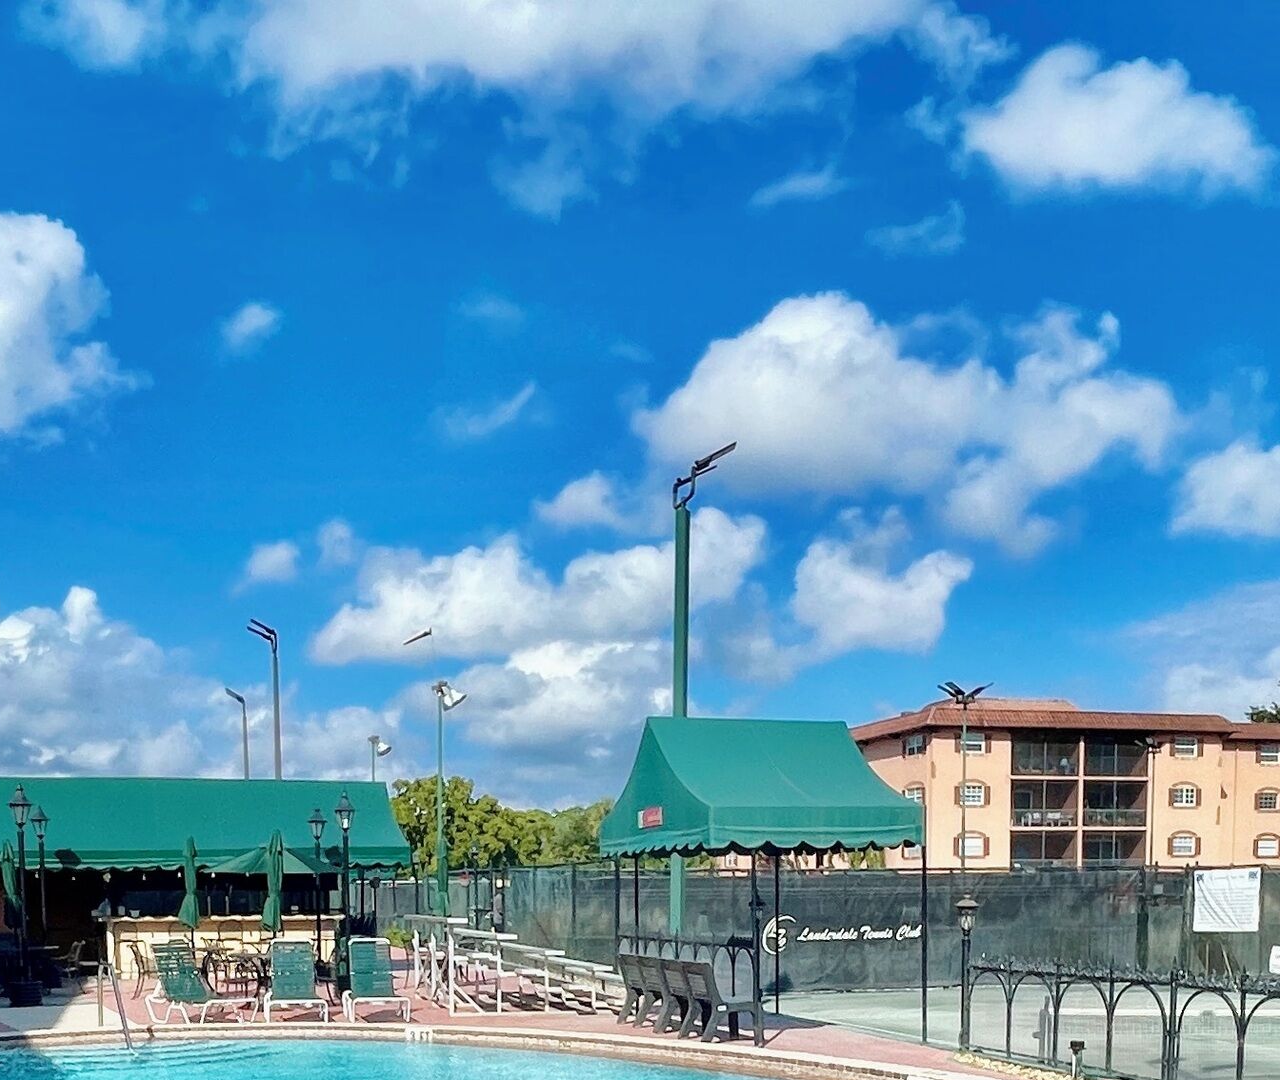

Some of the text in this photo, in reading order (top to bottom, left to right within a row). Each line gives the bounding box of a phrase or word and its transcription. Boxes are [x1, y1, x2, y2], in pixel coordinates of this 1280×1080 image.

[797, 923, 923, 942] Lauderdale Tennis Club
